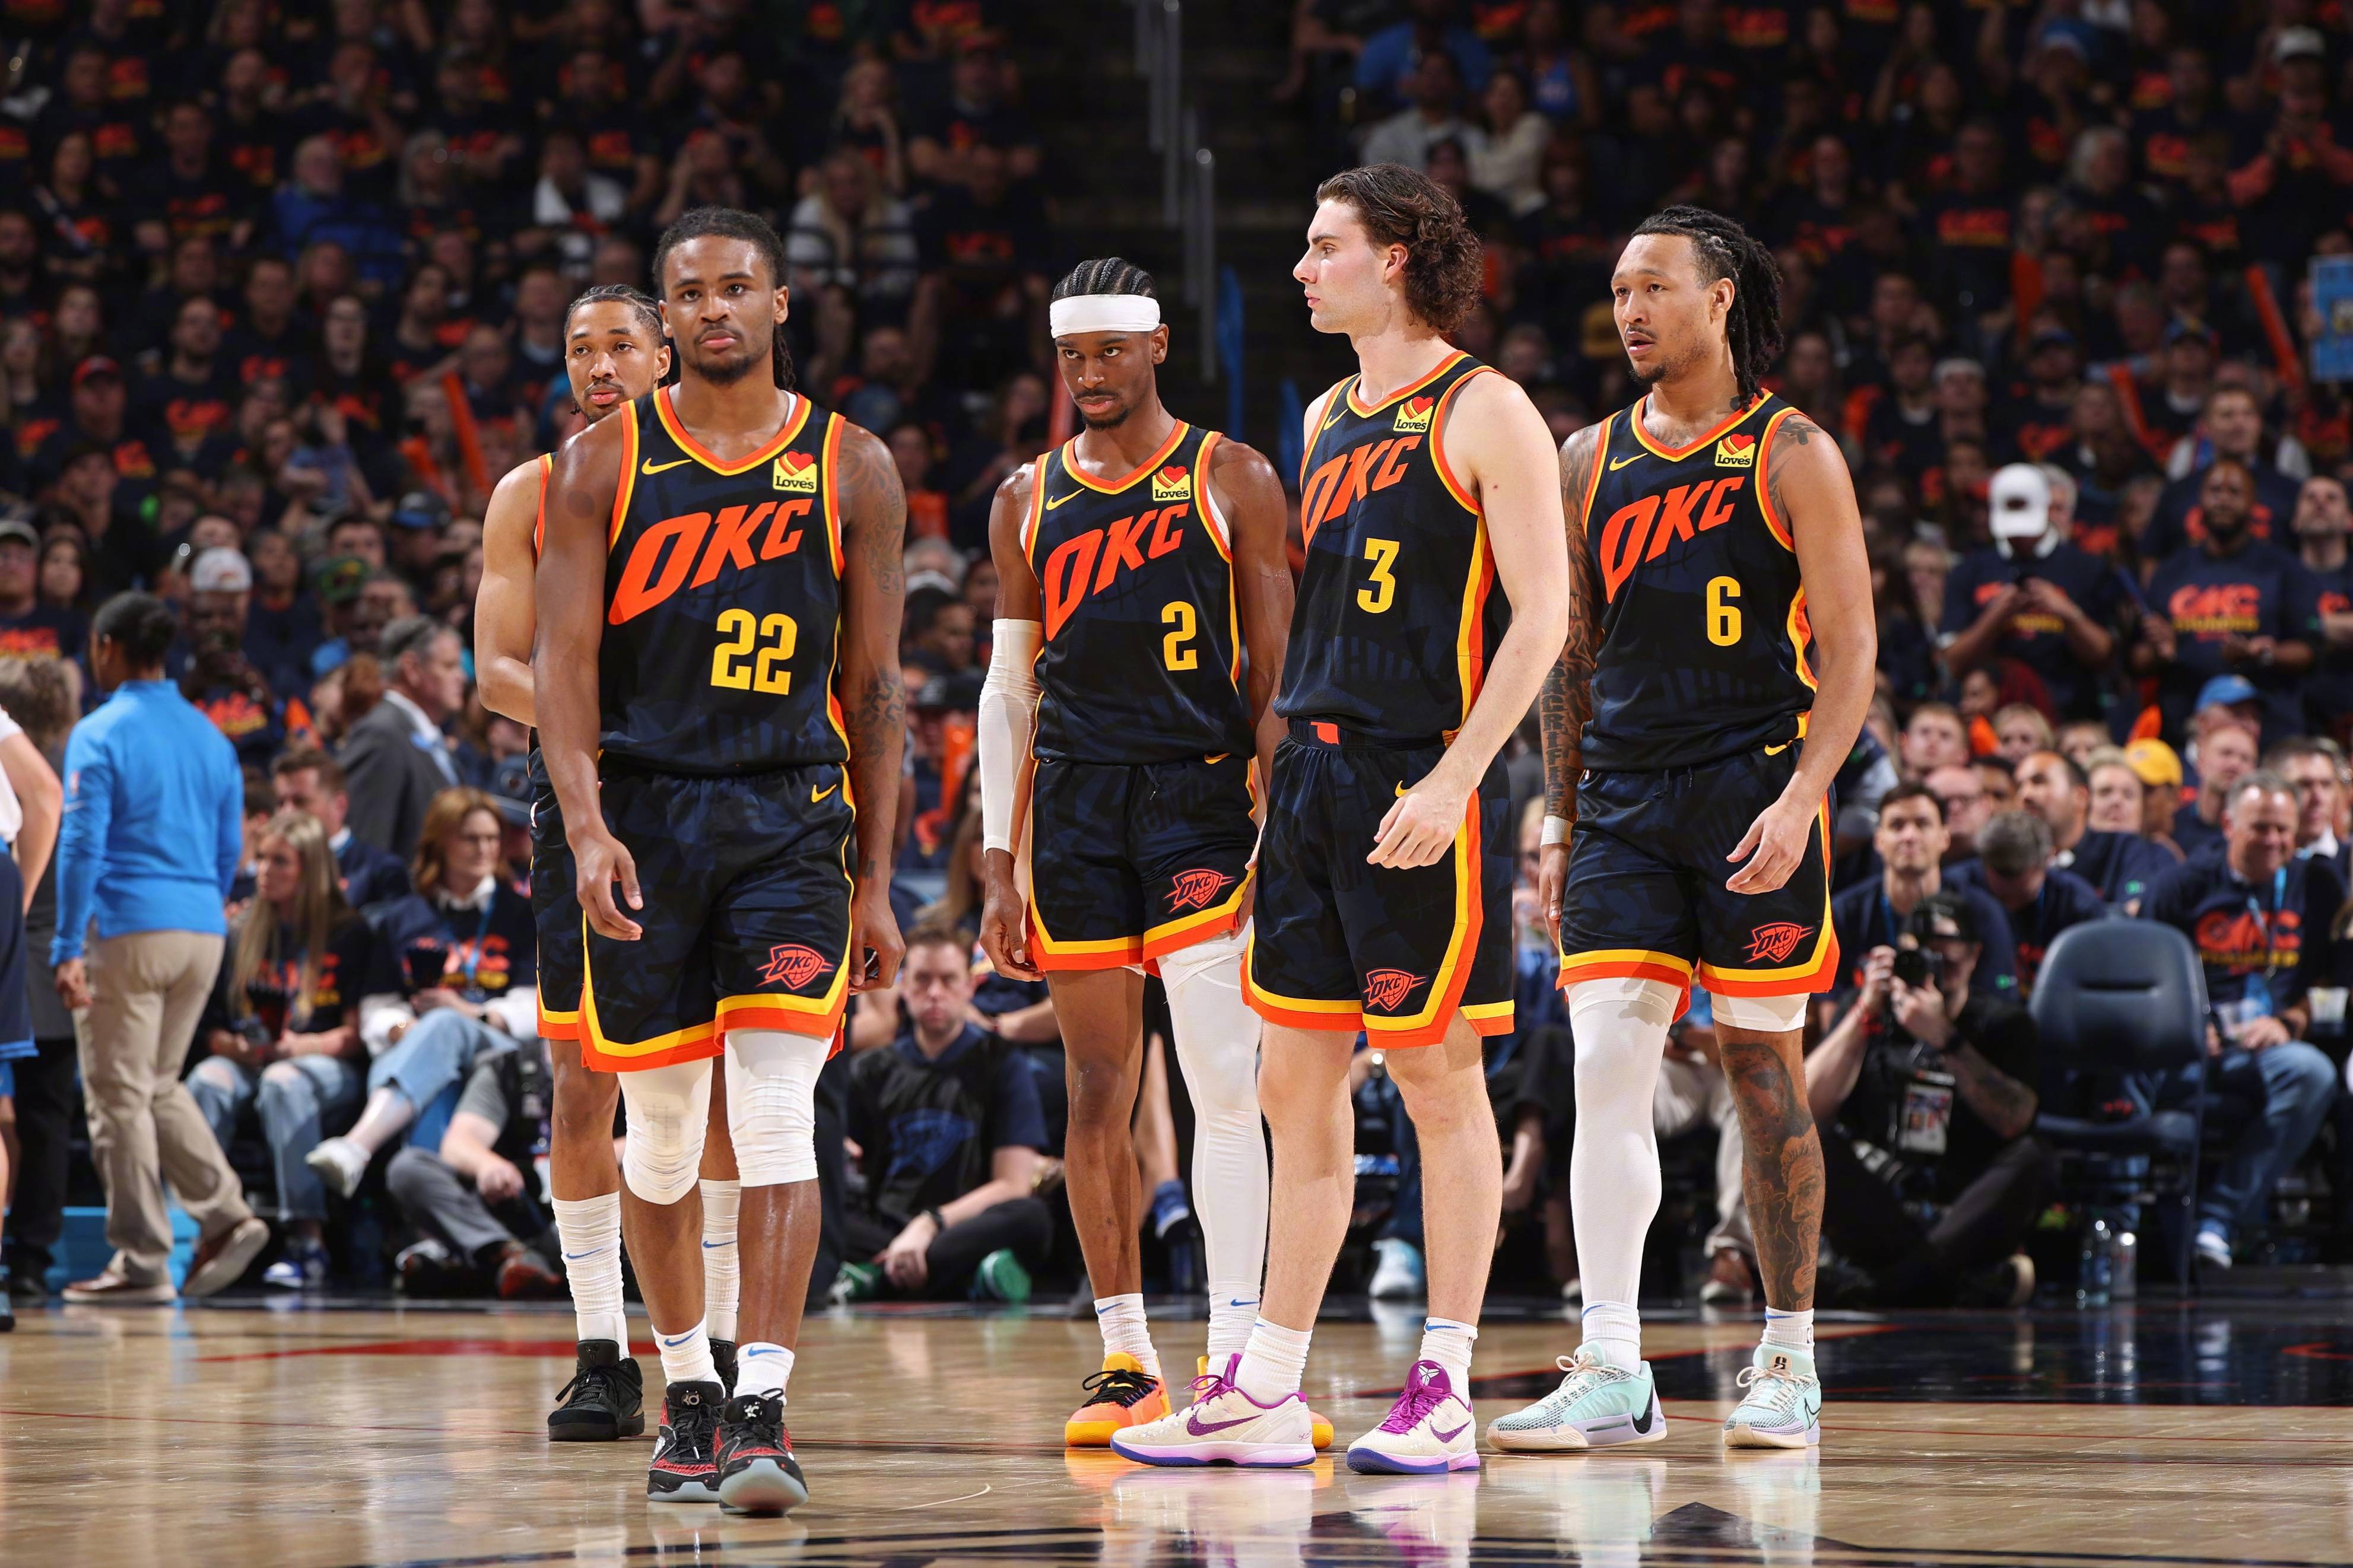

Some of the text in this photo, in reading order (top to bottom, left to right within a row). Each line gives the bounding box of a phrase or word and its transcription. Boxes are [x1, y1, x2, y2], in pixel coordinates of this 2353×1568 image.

[1301, 435, 1422, 556] OKC
[609, 499, 813, 625] OKC
[1044, 503, 1189, 642] OKC
[1357, 537, 1400, 613] 3
[1601, 476, 1744, 603] OKC
[1161, 601, 1198, 671] 2
[1706, 576, 1741, 647] 6
[710, 609, 798, 695] 22
[1177, 875, 1212, 902] OKC
[769, 956, 813, 976] OKC
[1755, 930, 1790, 955] OKC
[1370, 977, 1402, 1000] OKC
